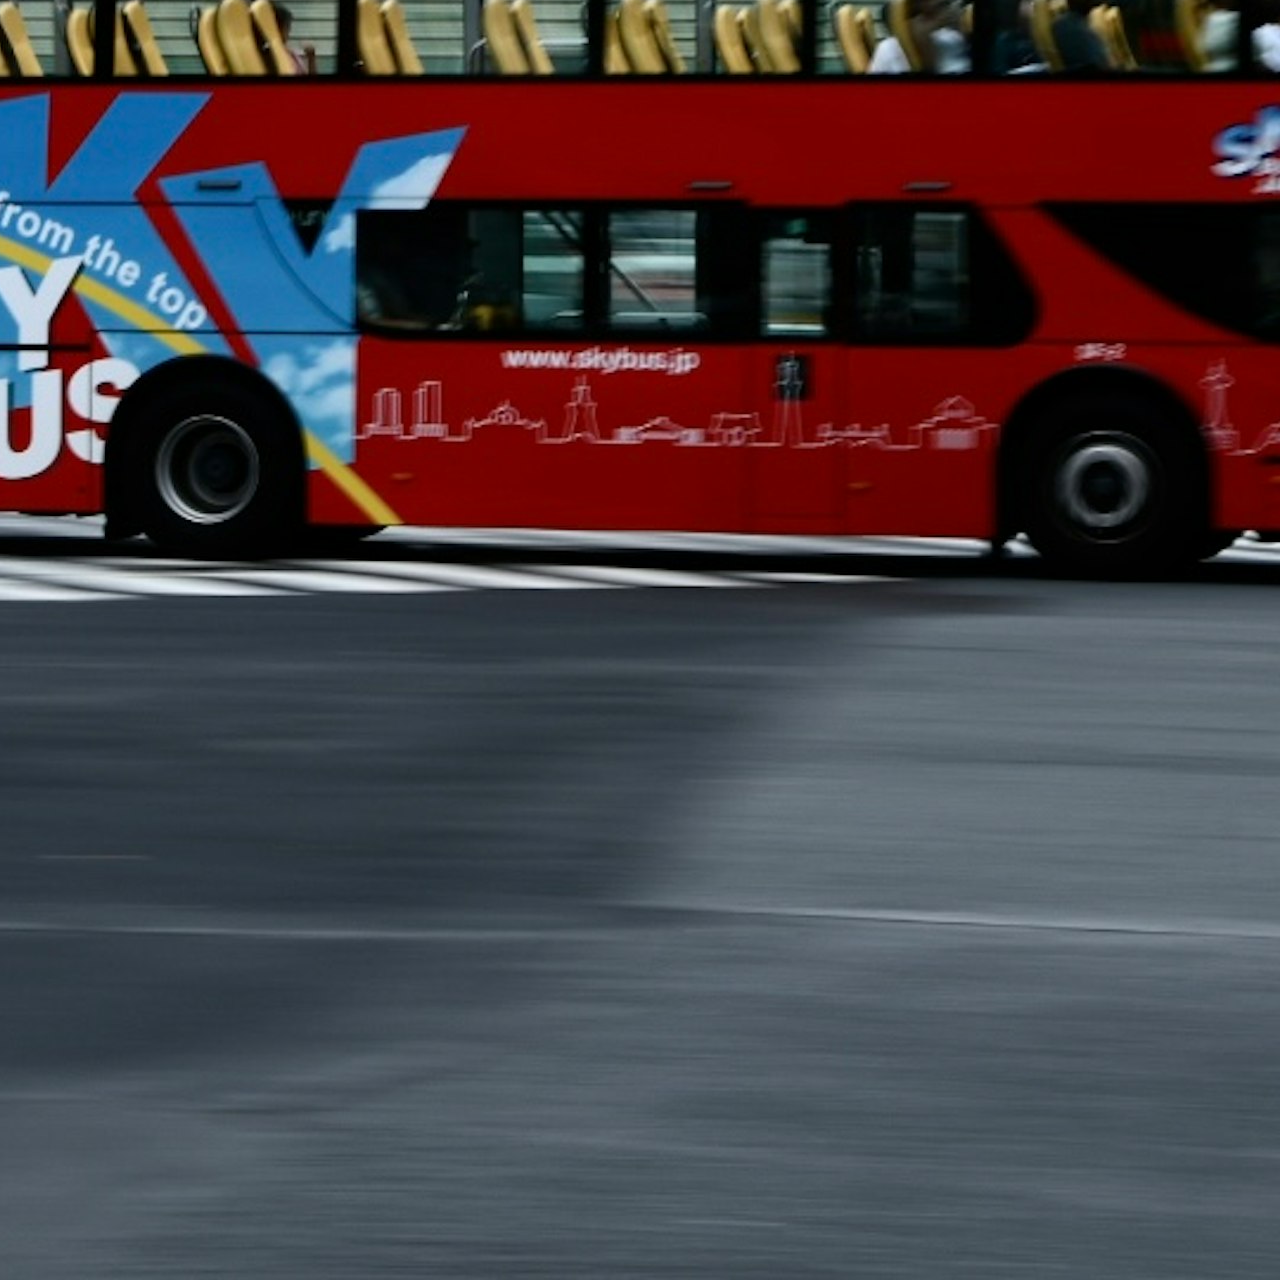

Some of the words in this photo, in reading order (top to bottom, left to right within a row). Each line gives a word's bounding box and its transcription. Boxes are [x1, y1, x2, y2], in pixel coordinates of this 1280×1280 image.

[84, 234, 140, 288] the
[146, 271, 208, 331] top
[500, 345, 701, 375] www.skybus.jp
